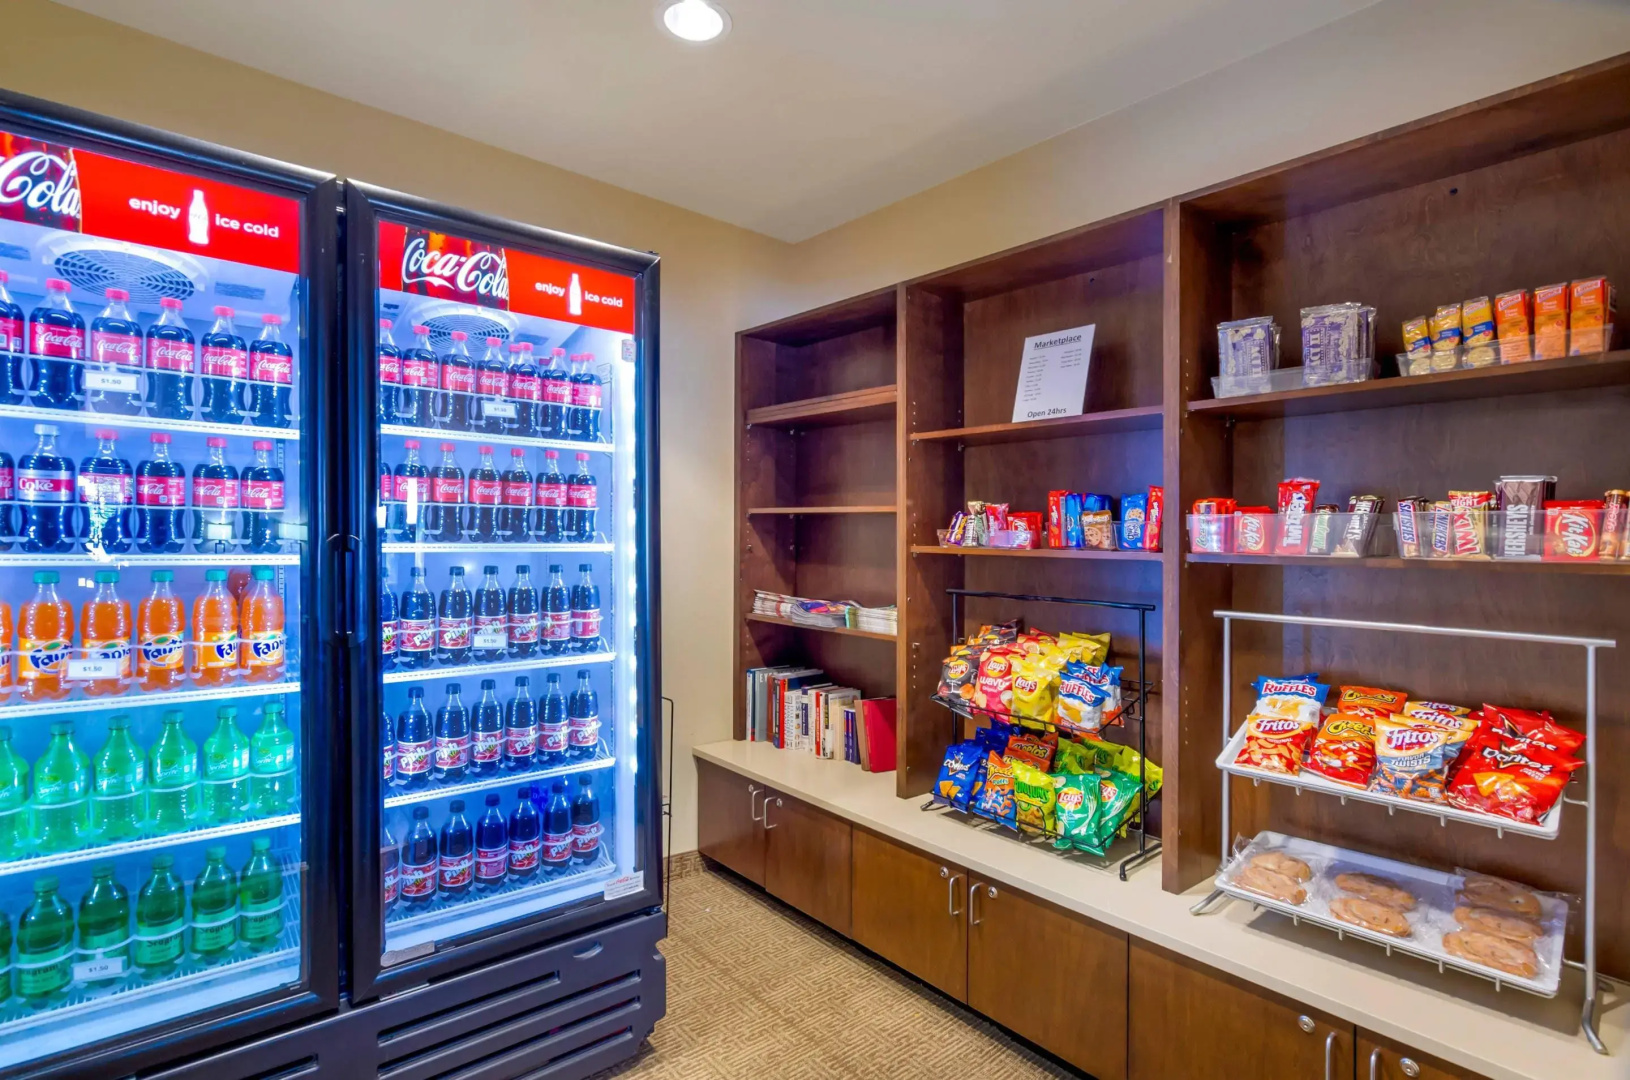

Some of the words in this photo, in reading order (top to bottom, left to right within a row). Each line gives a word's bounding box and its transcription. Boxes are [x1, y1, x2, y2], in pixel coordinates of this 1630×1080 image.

[128, 197, 181, 219] enjoy
[214, 213, 240, 231] ice
[243, 220, 279, 238] cold
[401, 237, 509, 301] Coca-Cola
[535, 281, 566, 297] enjoy
[584, 289, 600, 302] ice
[601, 294, 624, 308] cold
[42, 331, 83, 348] Coca-Cola
[1034, 334, 1082, 350] Marketplace
[97, 340, 138, 355] Coca-Cola
[156, 347, 192, 361] Coca-Cola
[203, 353, 238, 367] Coca-Cola
[258, 360, 291, 373] Coca-Cola
[1027, 408, 1046, 418] Open
[1047, 407, 1067, 416] 24hrs
[19, 478, 54, 492] Coke
[1399, 502, 1417, 543] SATISFIES
[1060, 680, 1095, 703] RUFFLES
[1262, 682, 1317, 696] RUFFLES
[1257, 719, 1300, 732] Fritos
[1411, 710, 1463, 729] Fritos
[1386, 728, 1439, 749] Fritos
[1391, 756, 1431, 767] TWISTS
[1482, 747, 1553, 772] Doritos
[88, 964, 110, 974] $1.50
